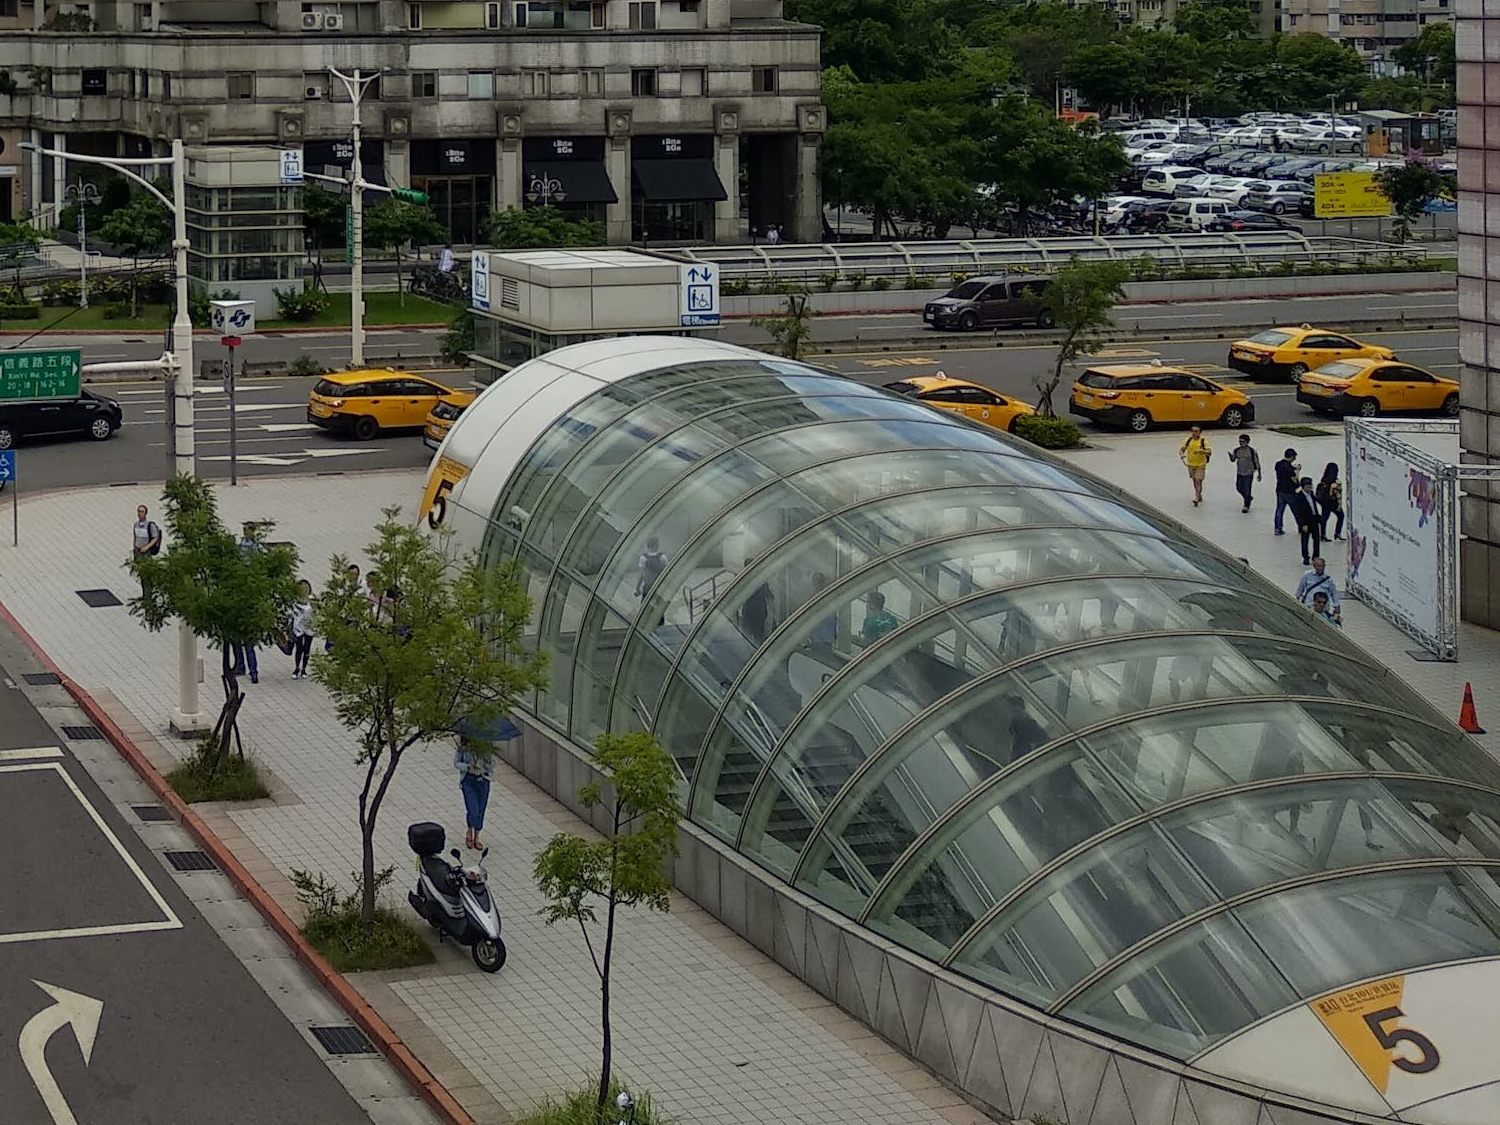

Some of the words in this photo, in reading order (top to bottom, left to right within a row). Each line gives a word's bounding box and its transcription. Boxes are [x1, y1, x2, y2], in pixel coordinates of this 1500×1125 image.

[4, 355, 72, 369] 信義路五段
[429, 479, 455, 529] 5
[1362, 1006, 1440, 1074] 5
